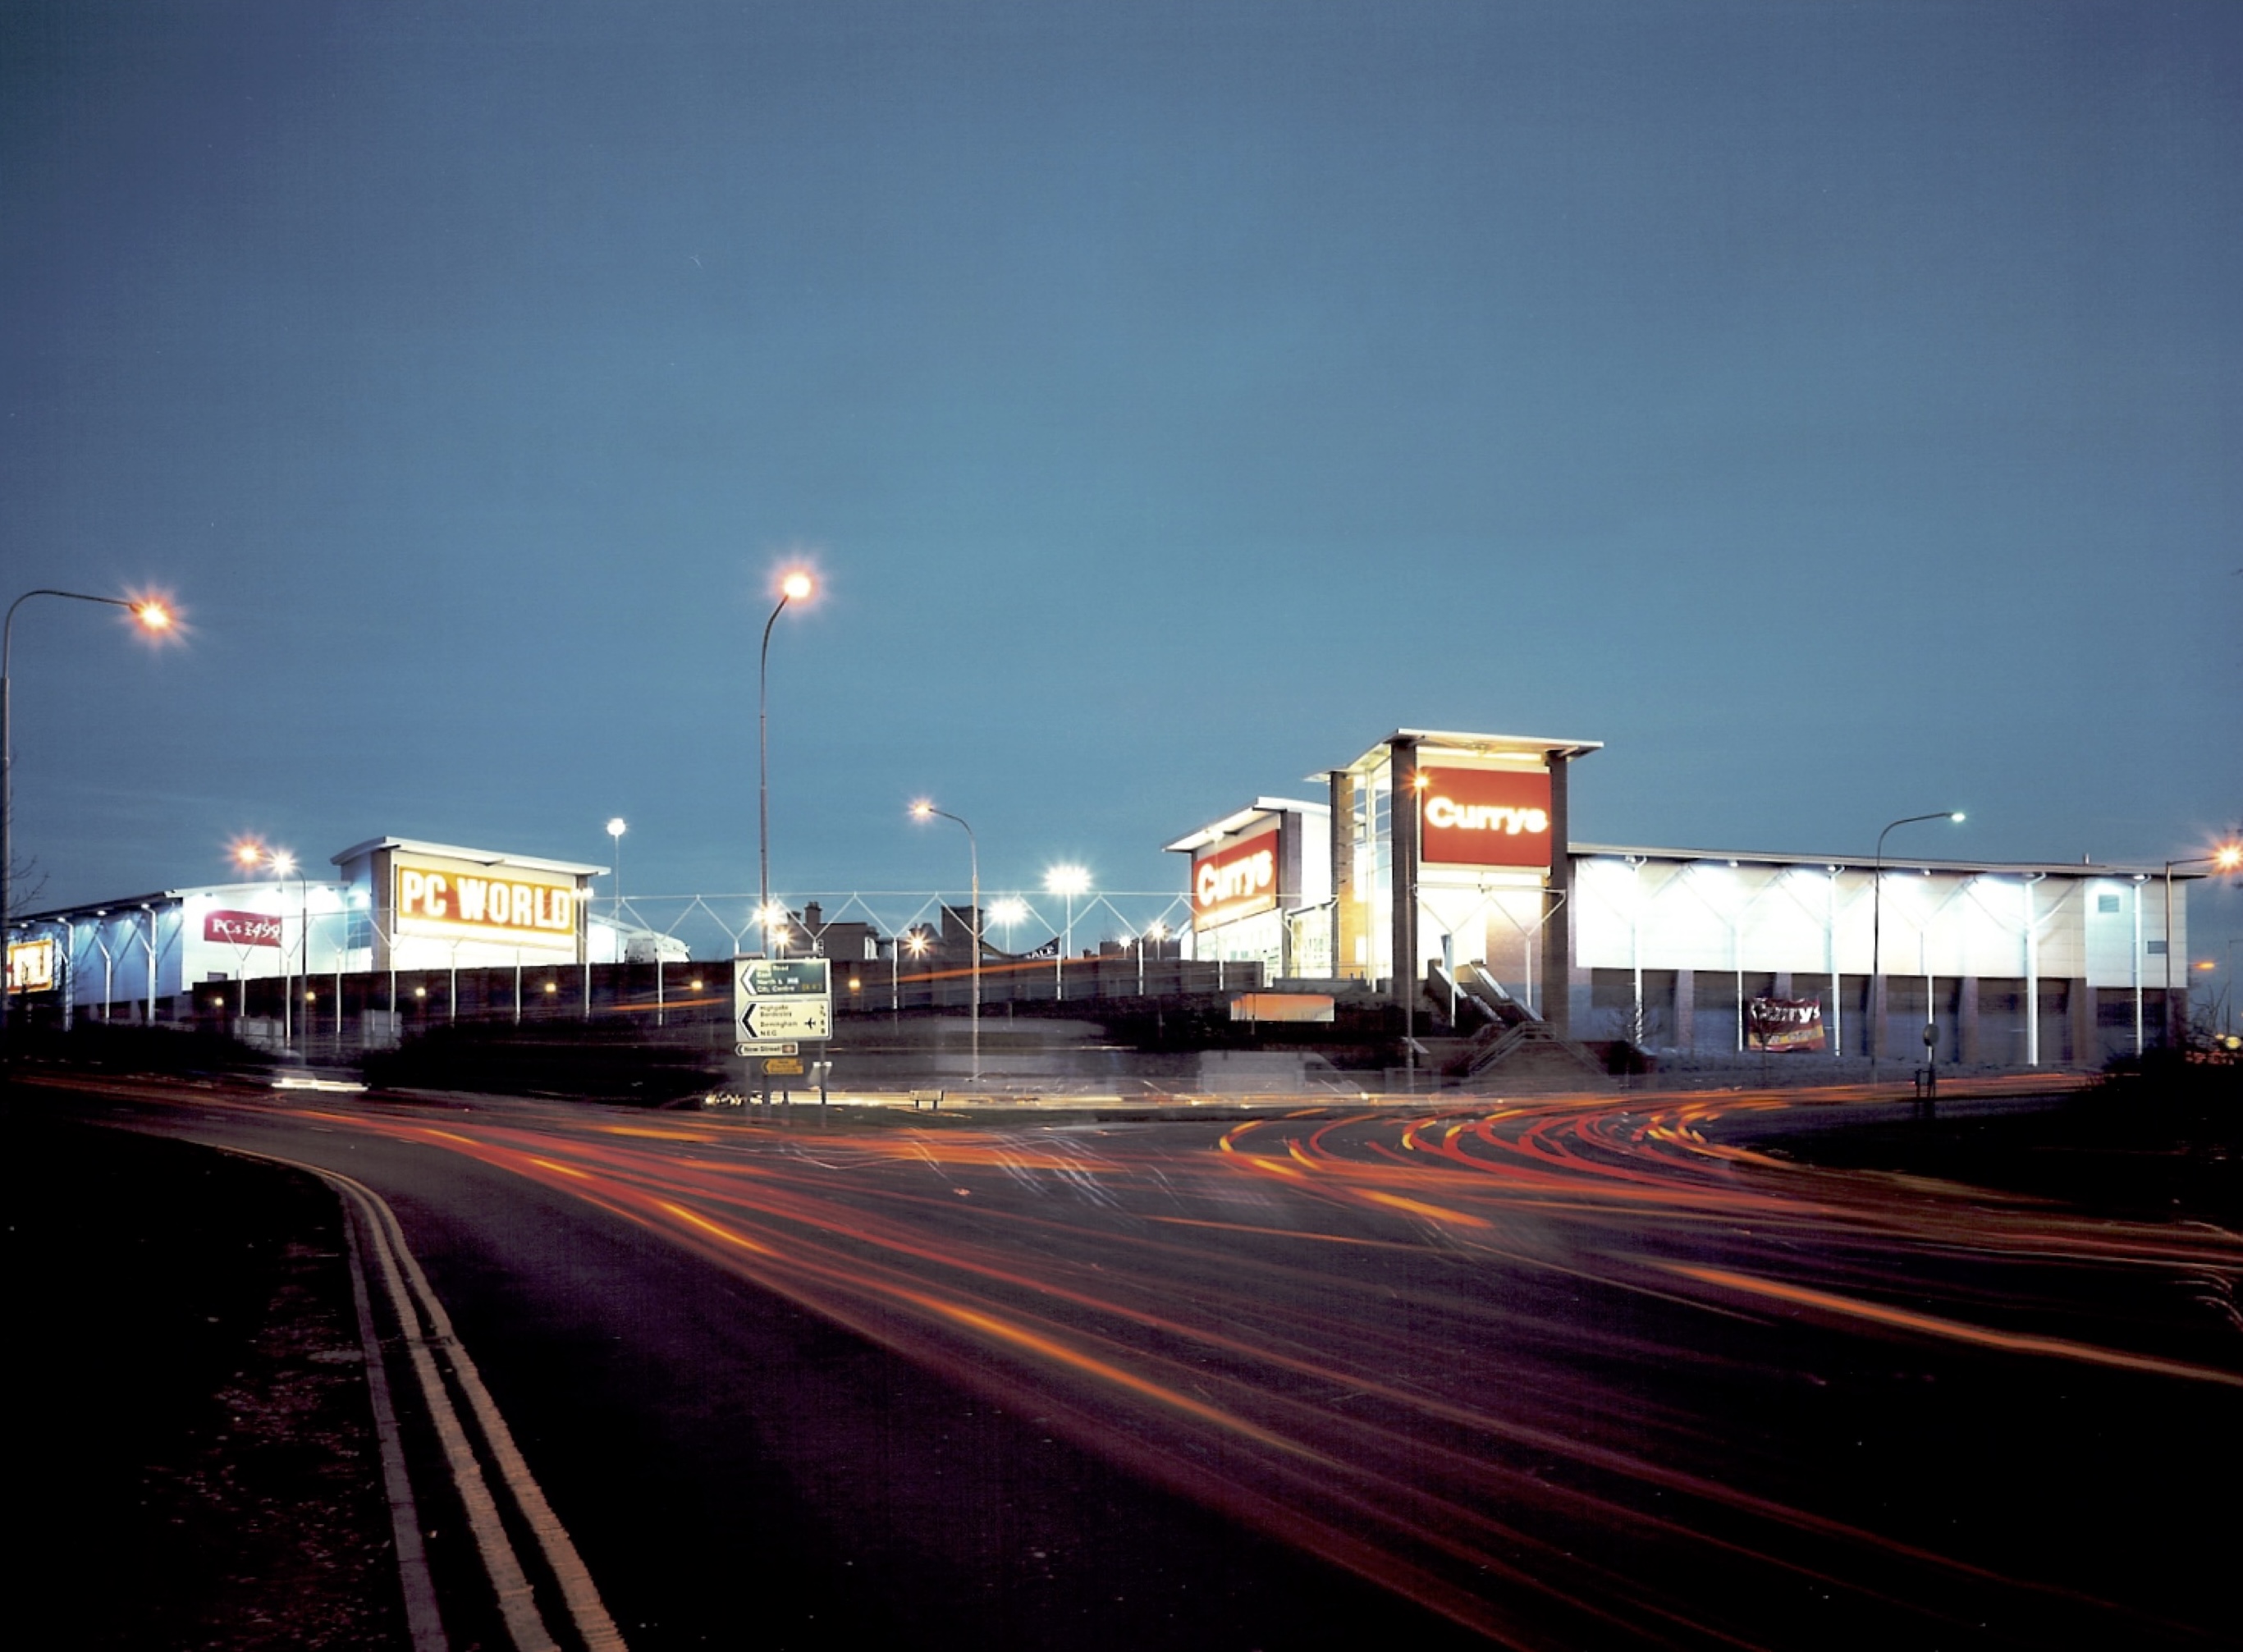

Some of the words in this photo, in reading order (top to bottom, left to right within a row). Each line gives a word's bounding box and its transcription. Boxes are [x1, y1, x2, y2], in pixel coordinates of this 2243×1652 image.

[1425, 796, 1548, 835] Currys
[402, 871, 446, 917] PC
[457, 877, 572, 930] WORLD
[1197, 849, 1273, 907] Currys
